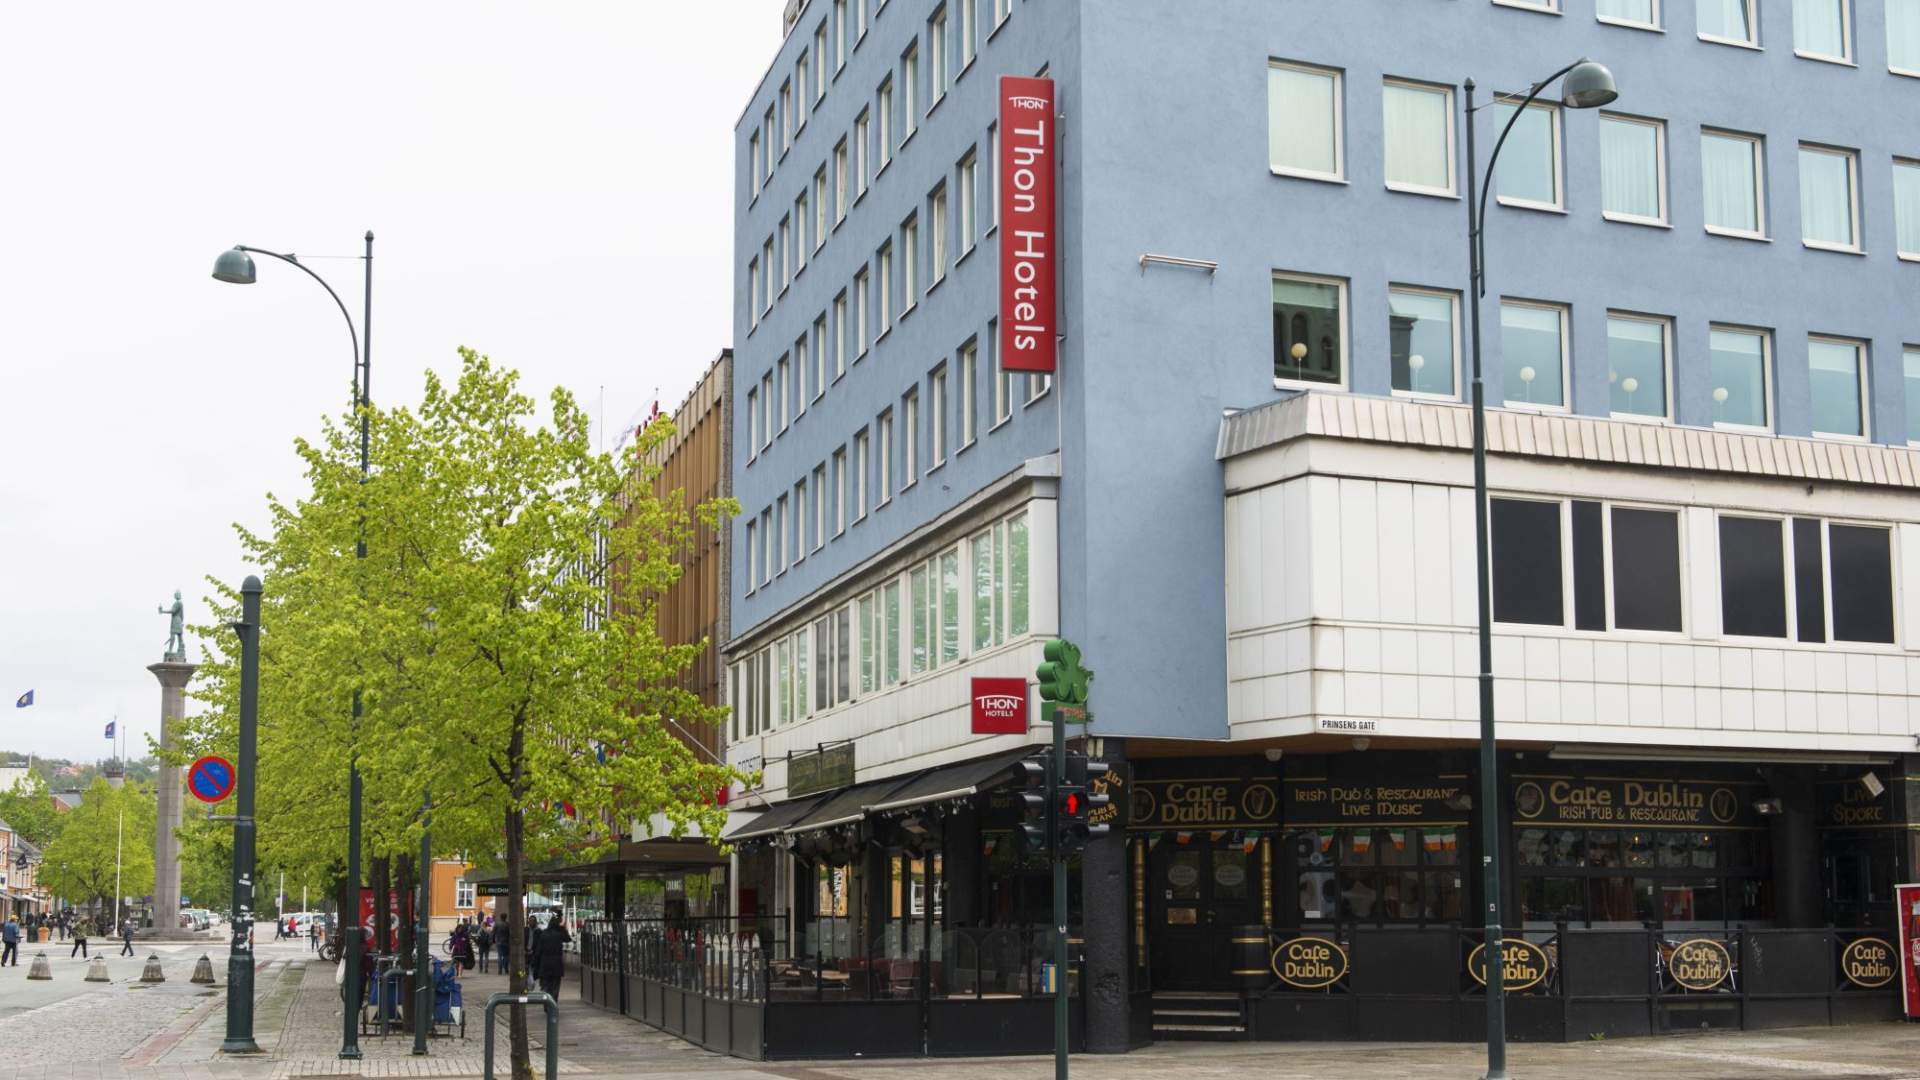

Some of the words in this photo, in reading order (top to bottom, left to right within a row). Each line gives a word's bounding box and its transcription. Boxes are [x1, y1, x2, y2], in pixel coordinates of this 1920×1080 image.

[1008, 96, 1048, 110] THON
[1013, 120, 1044, 213] Thon
[1014, 231, 1045, 350] Hotels
[976, 694, 1024, 710] THON
[1322, 719, 1357, 730] PRINSENS
[1359, 720, 1375, 731] GATE
[1166, 783, 1228, 806] Cafe
[1364, 789, 1373, 801] &
[1550, 780, 1612, 809] Cafe
[1623, 782, 1704, 808] Dublin
[1161, 803, 1236, 823] Dublin
[1559, 807, 1586, 819] IRISH
[1591, 808, 1613, 820] PUB
[1616, 809, 1625, 820] &
[1630, 808, 1700, 822] RESTAURANT
[1289, 944, 1330, 963] Cafe
[1502, 946, 1530, 966] afe
[1682, 946, 1718, 966] Cafe
[1854, 944, 1886, 963] Cafe
[1285, 962, 1334, 978] Dublin
[1680, 964, 1721, 979] Dublin
[1852, 962, 1891, 977] Dublin
